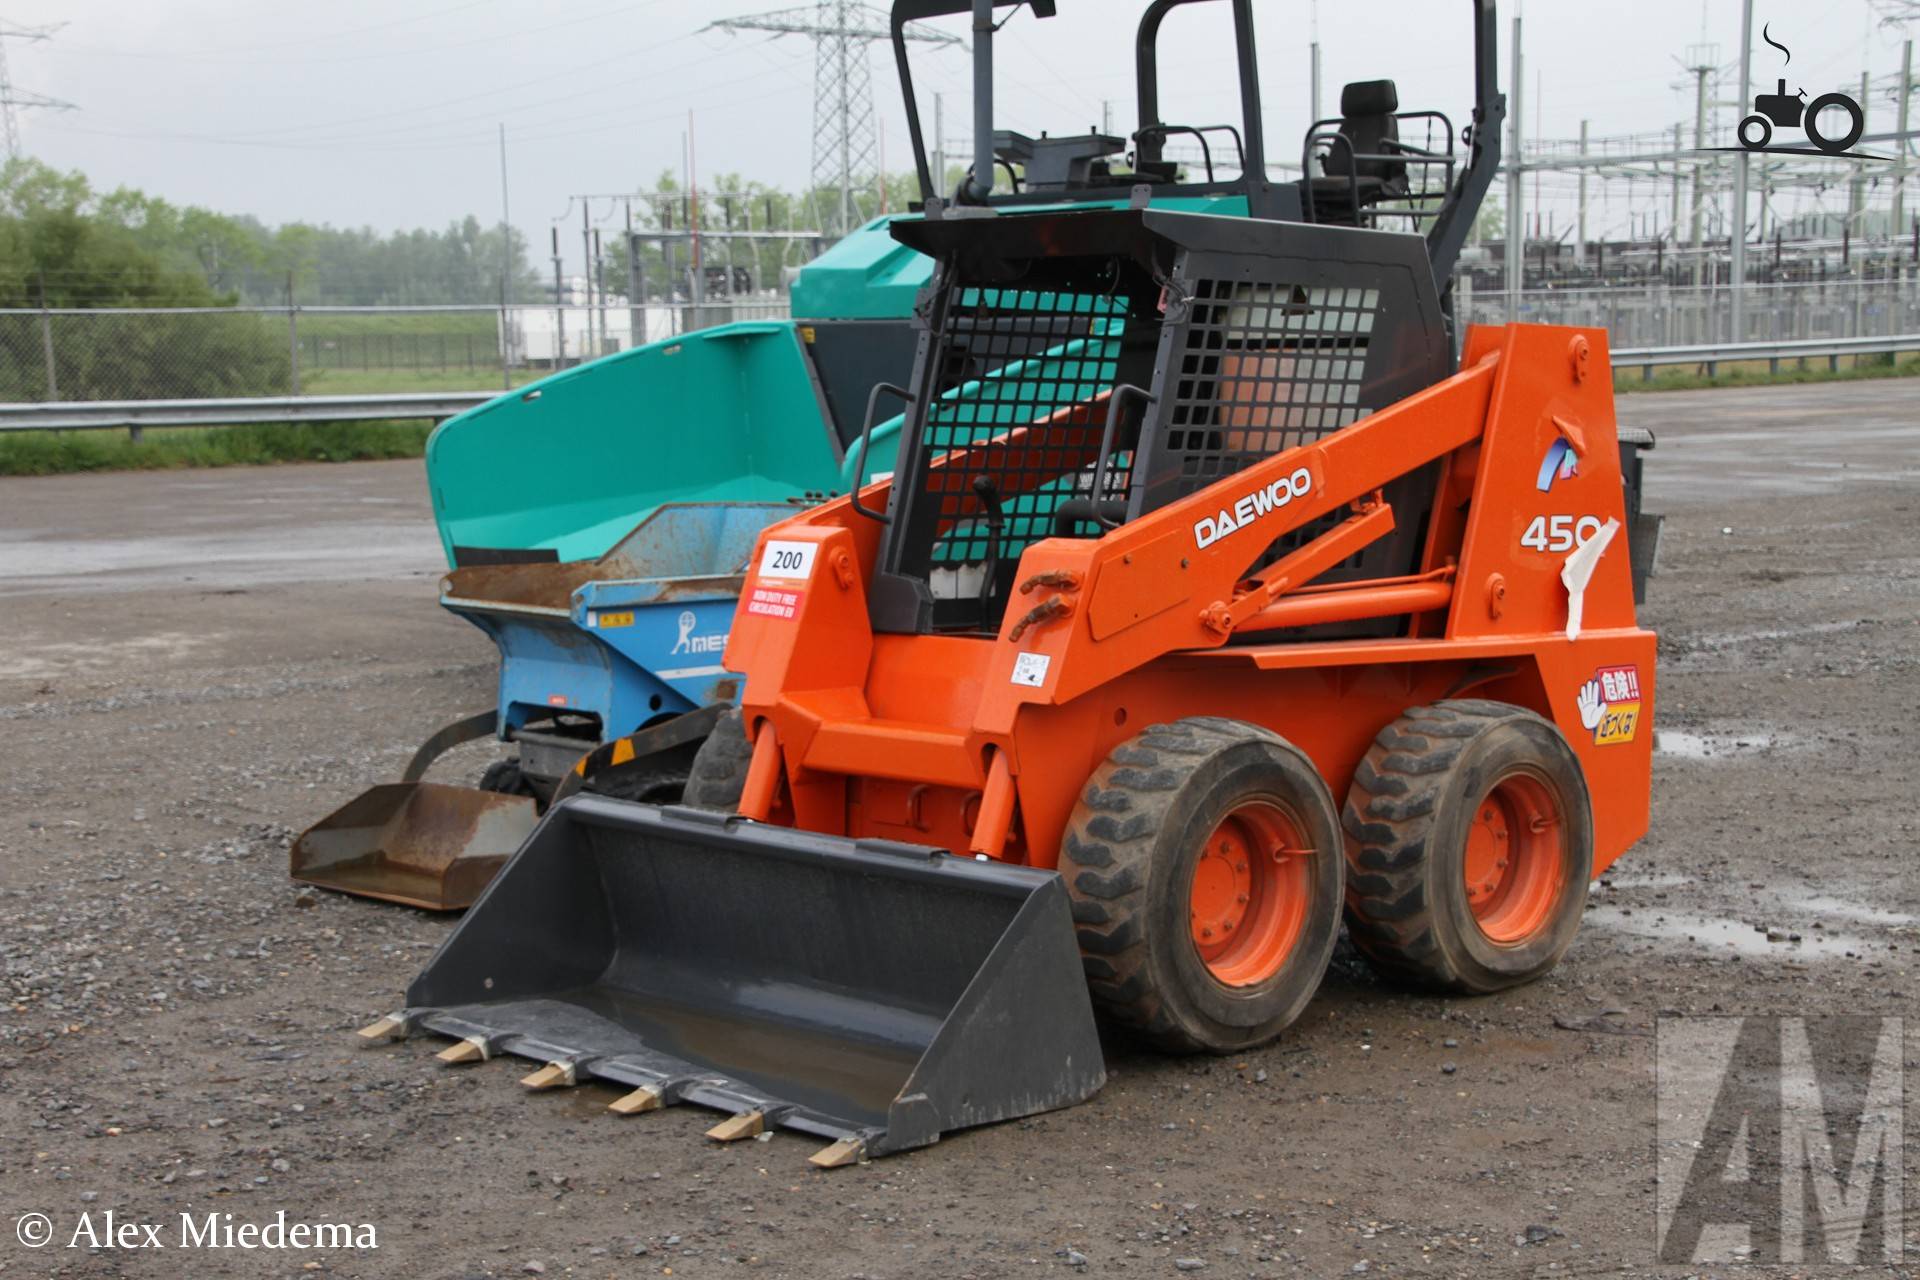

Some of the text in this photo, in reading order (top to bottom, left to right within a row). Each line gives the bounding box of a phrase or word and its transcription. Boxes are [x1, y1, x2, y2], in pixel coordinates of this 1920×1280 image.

[1194, 467, 1312, 550] DAEWOO
[1520, 515, 1602, 552] 450
[772, 550, 803, 570] 200
[748, 601, 785, 616] CIRCULATION
[767, 592, 782, 603] DUTY
[781, 594, 797, 605] FREE
